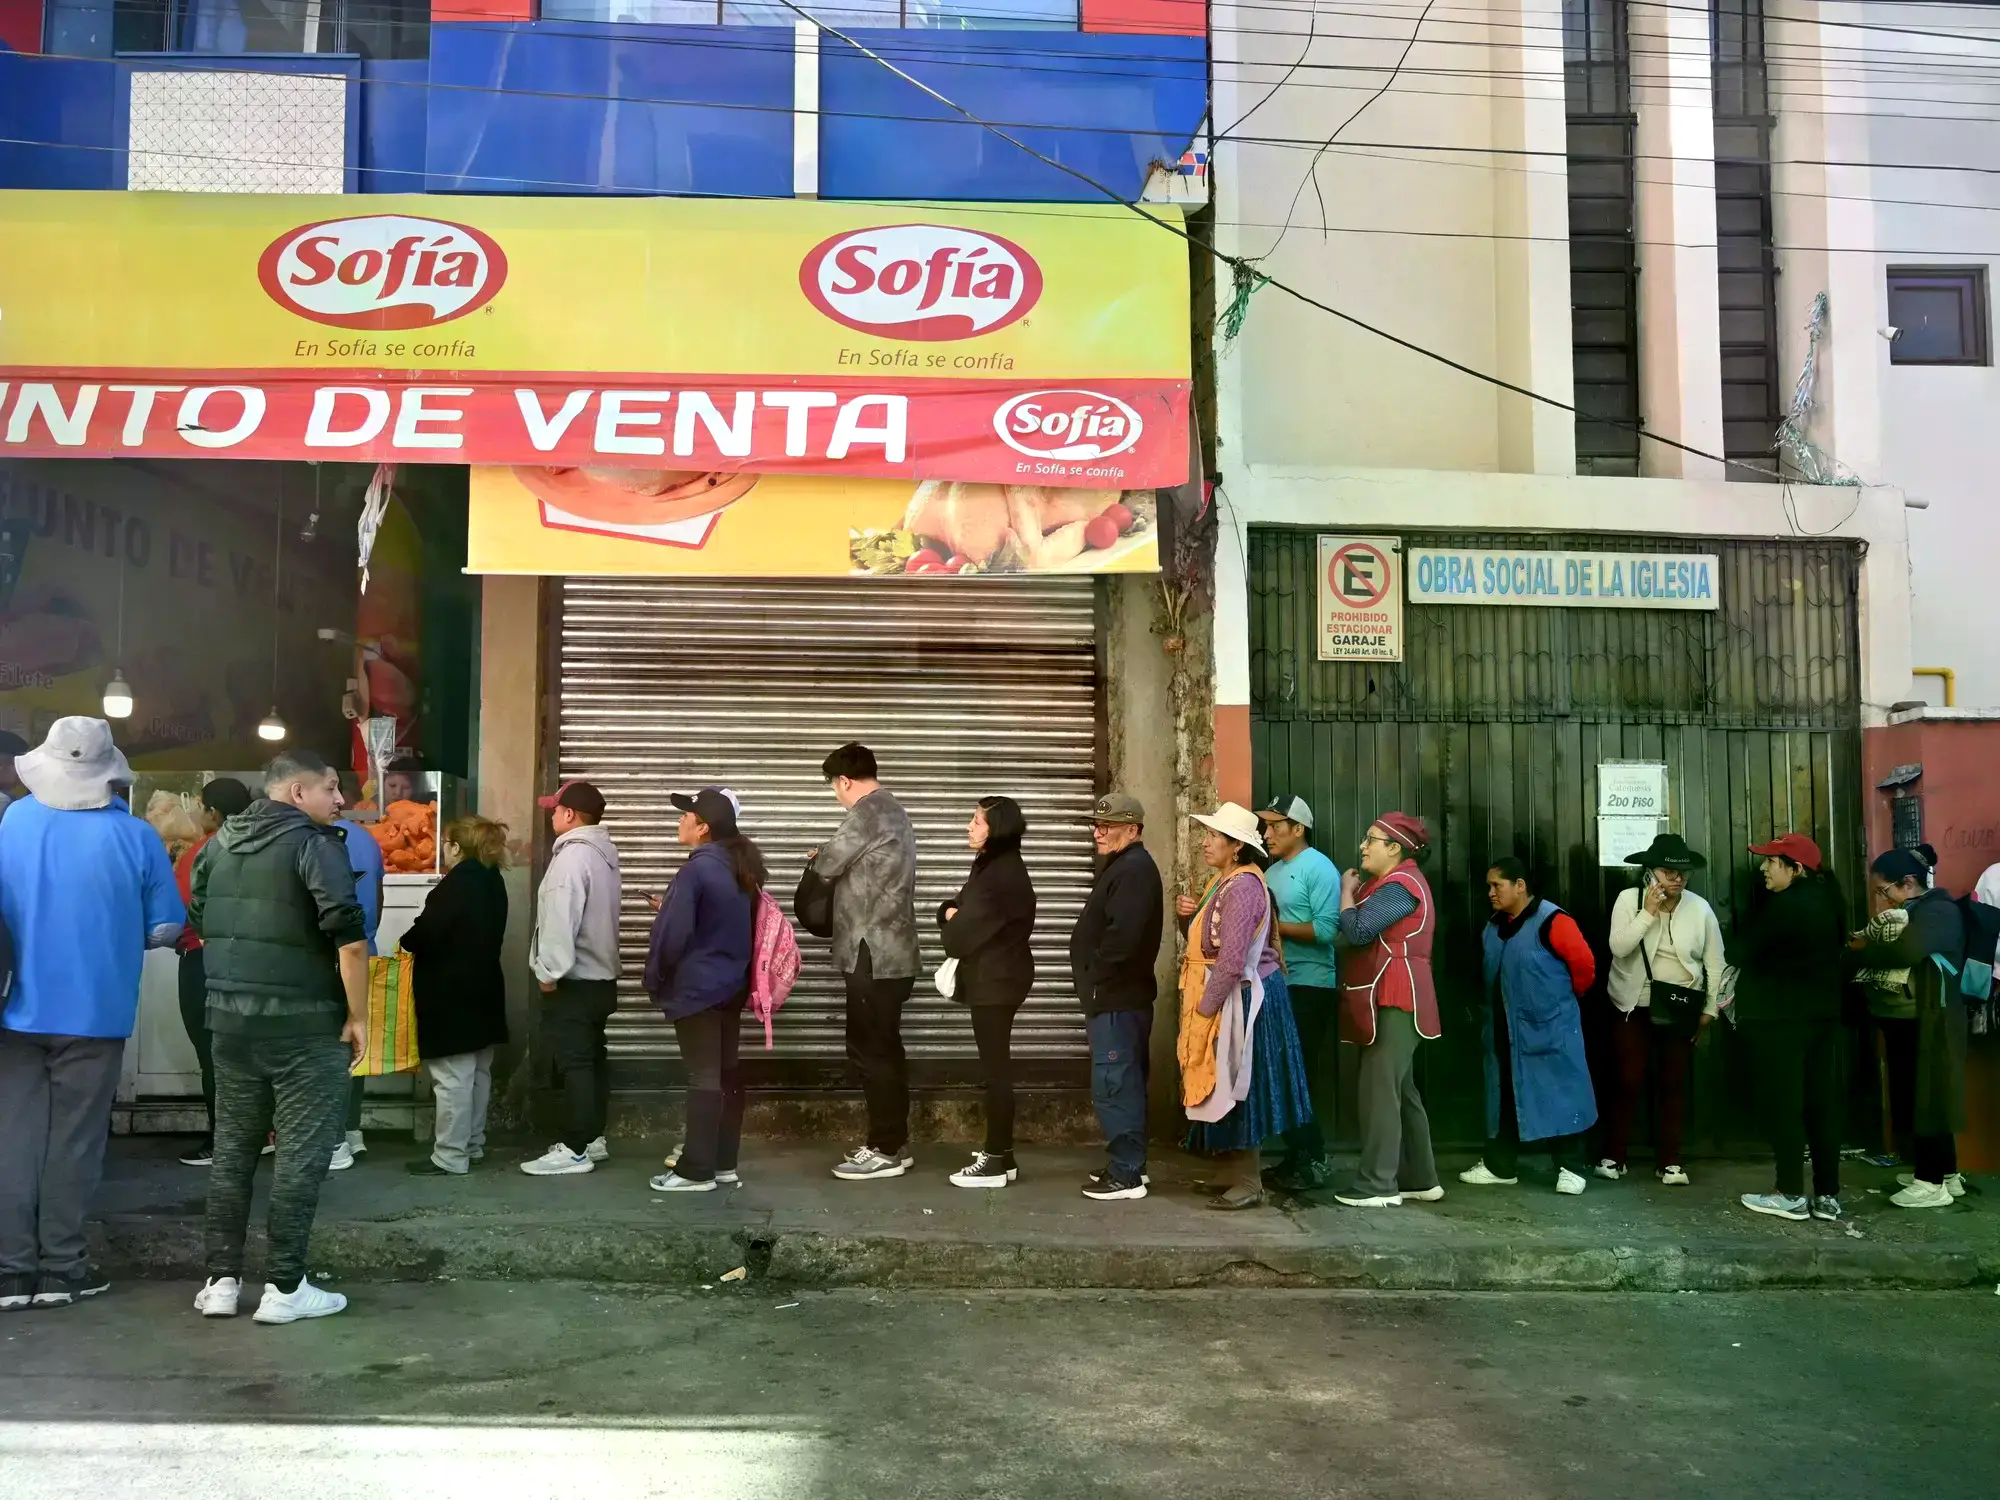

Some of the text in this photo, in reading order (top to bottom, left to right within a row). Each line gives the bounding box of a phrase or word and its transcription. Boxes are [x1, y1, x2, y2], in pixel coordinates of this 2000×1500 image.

[289, 235, 479, 301] Sofía
[831, 244, 1015, 311] Sofía
[295, 338, 476, 357] En Sofía se confía
[838, 348, 1014, 370] En Sofía se confía
[304, 386, 475, 448] DE
[513, 388, 908, 463] VENTA
[1012, 403, 1126, 445] Sofía
[1015, 462, 1124, 478] En Sofía se confía
[1417, 554, 1711, 599] OBRA SOCIAL DE LA IGLESIA
[1331, 612, 1388, 622] PROHIBIDO
[1327, 624, 1393, 634] ESTACIONAR
[1332, 635, 1386, 646] GARAJE
[1608, 794, 1629, 807] 2DO
